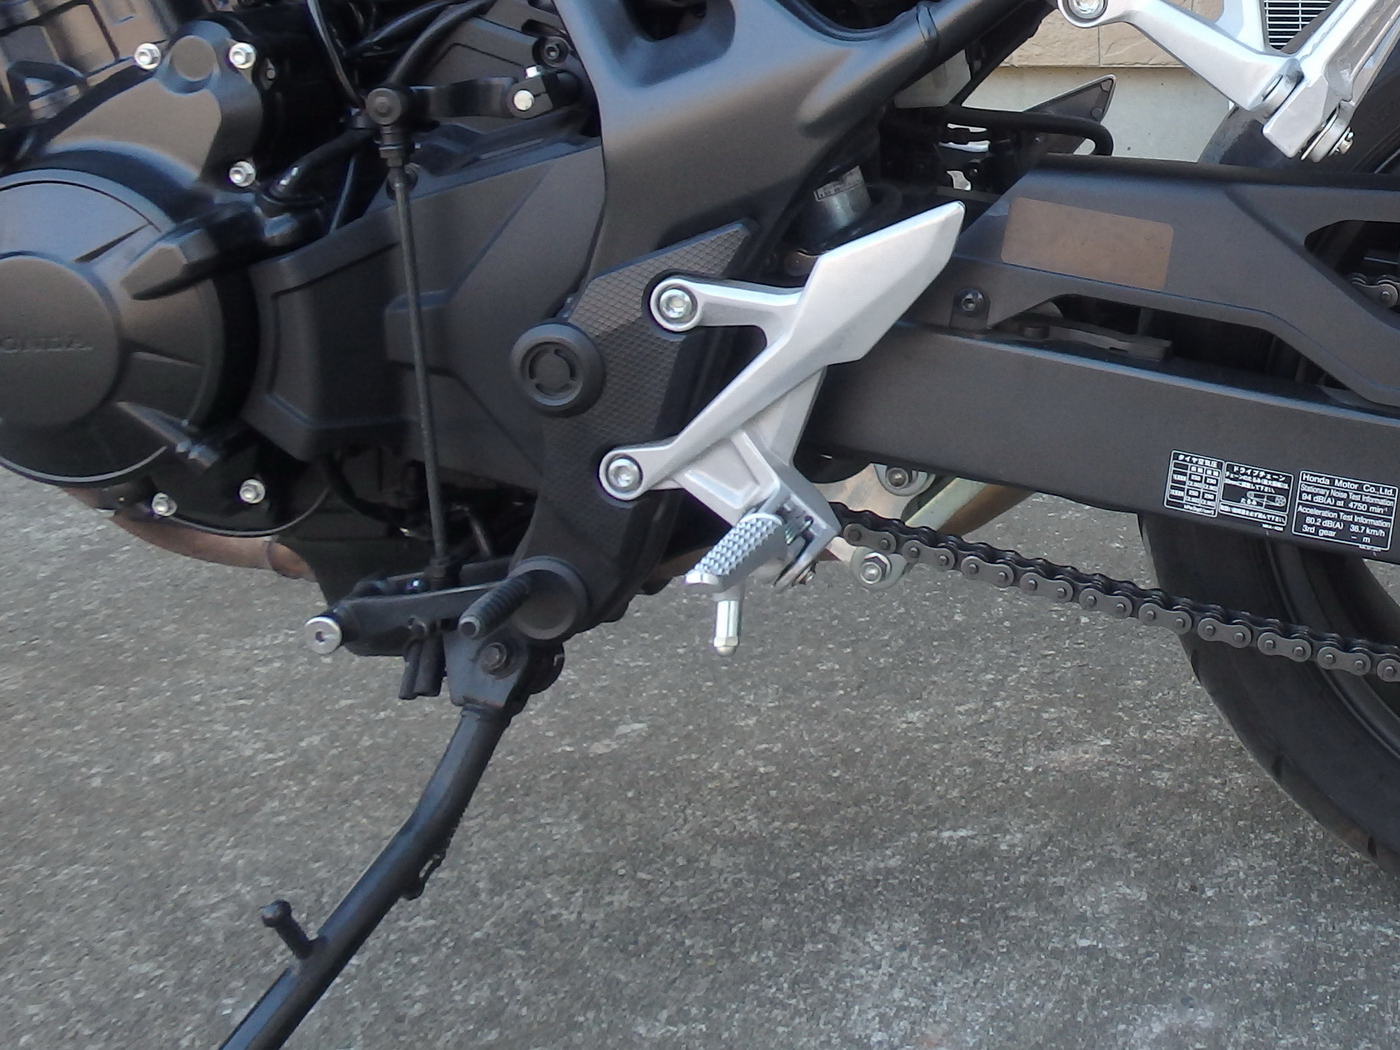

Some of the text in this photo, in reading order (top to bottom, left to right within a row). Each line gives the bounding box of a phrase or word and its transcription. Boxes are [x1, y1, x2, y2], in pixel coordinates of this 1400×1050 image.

[1302, 473, 1330, 485] Honda
[1334, 479, 1359, 490] Motor
[1301, 484, 1394, 507] Stationary Noise Test Information
[1302, 493, 1312, 501] 94
[1313, 495, 1335, 505] dB(A)
[1348, 501, 1367, 511] 4750
[1297, 505, 1391, 528] Acceleration Test Information
[1302, 524, 1315, 533] 3rd
[1318, 529, 1337, 537] gear
[1322, 519, 1344, 529] dB(A)
[1366, 527, 1385, 537] km/h
